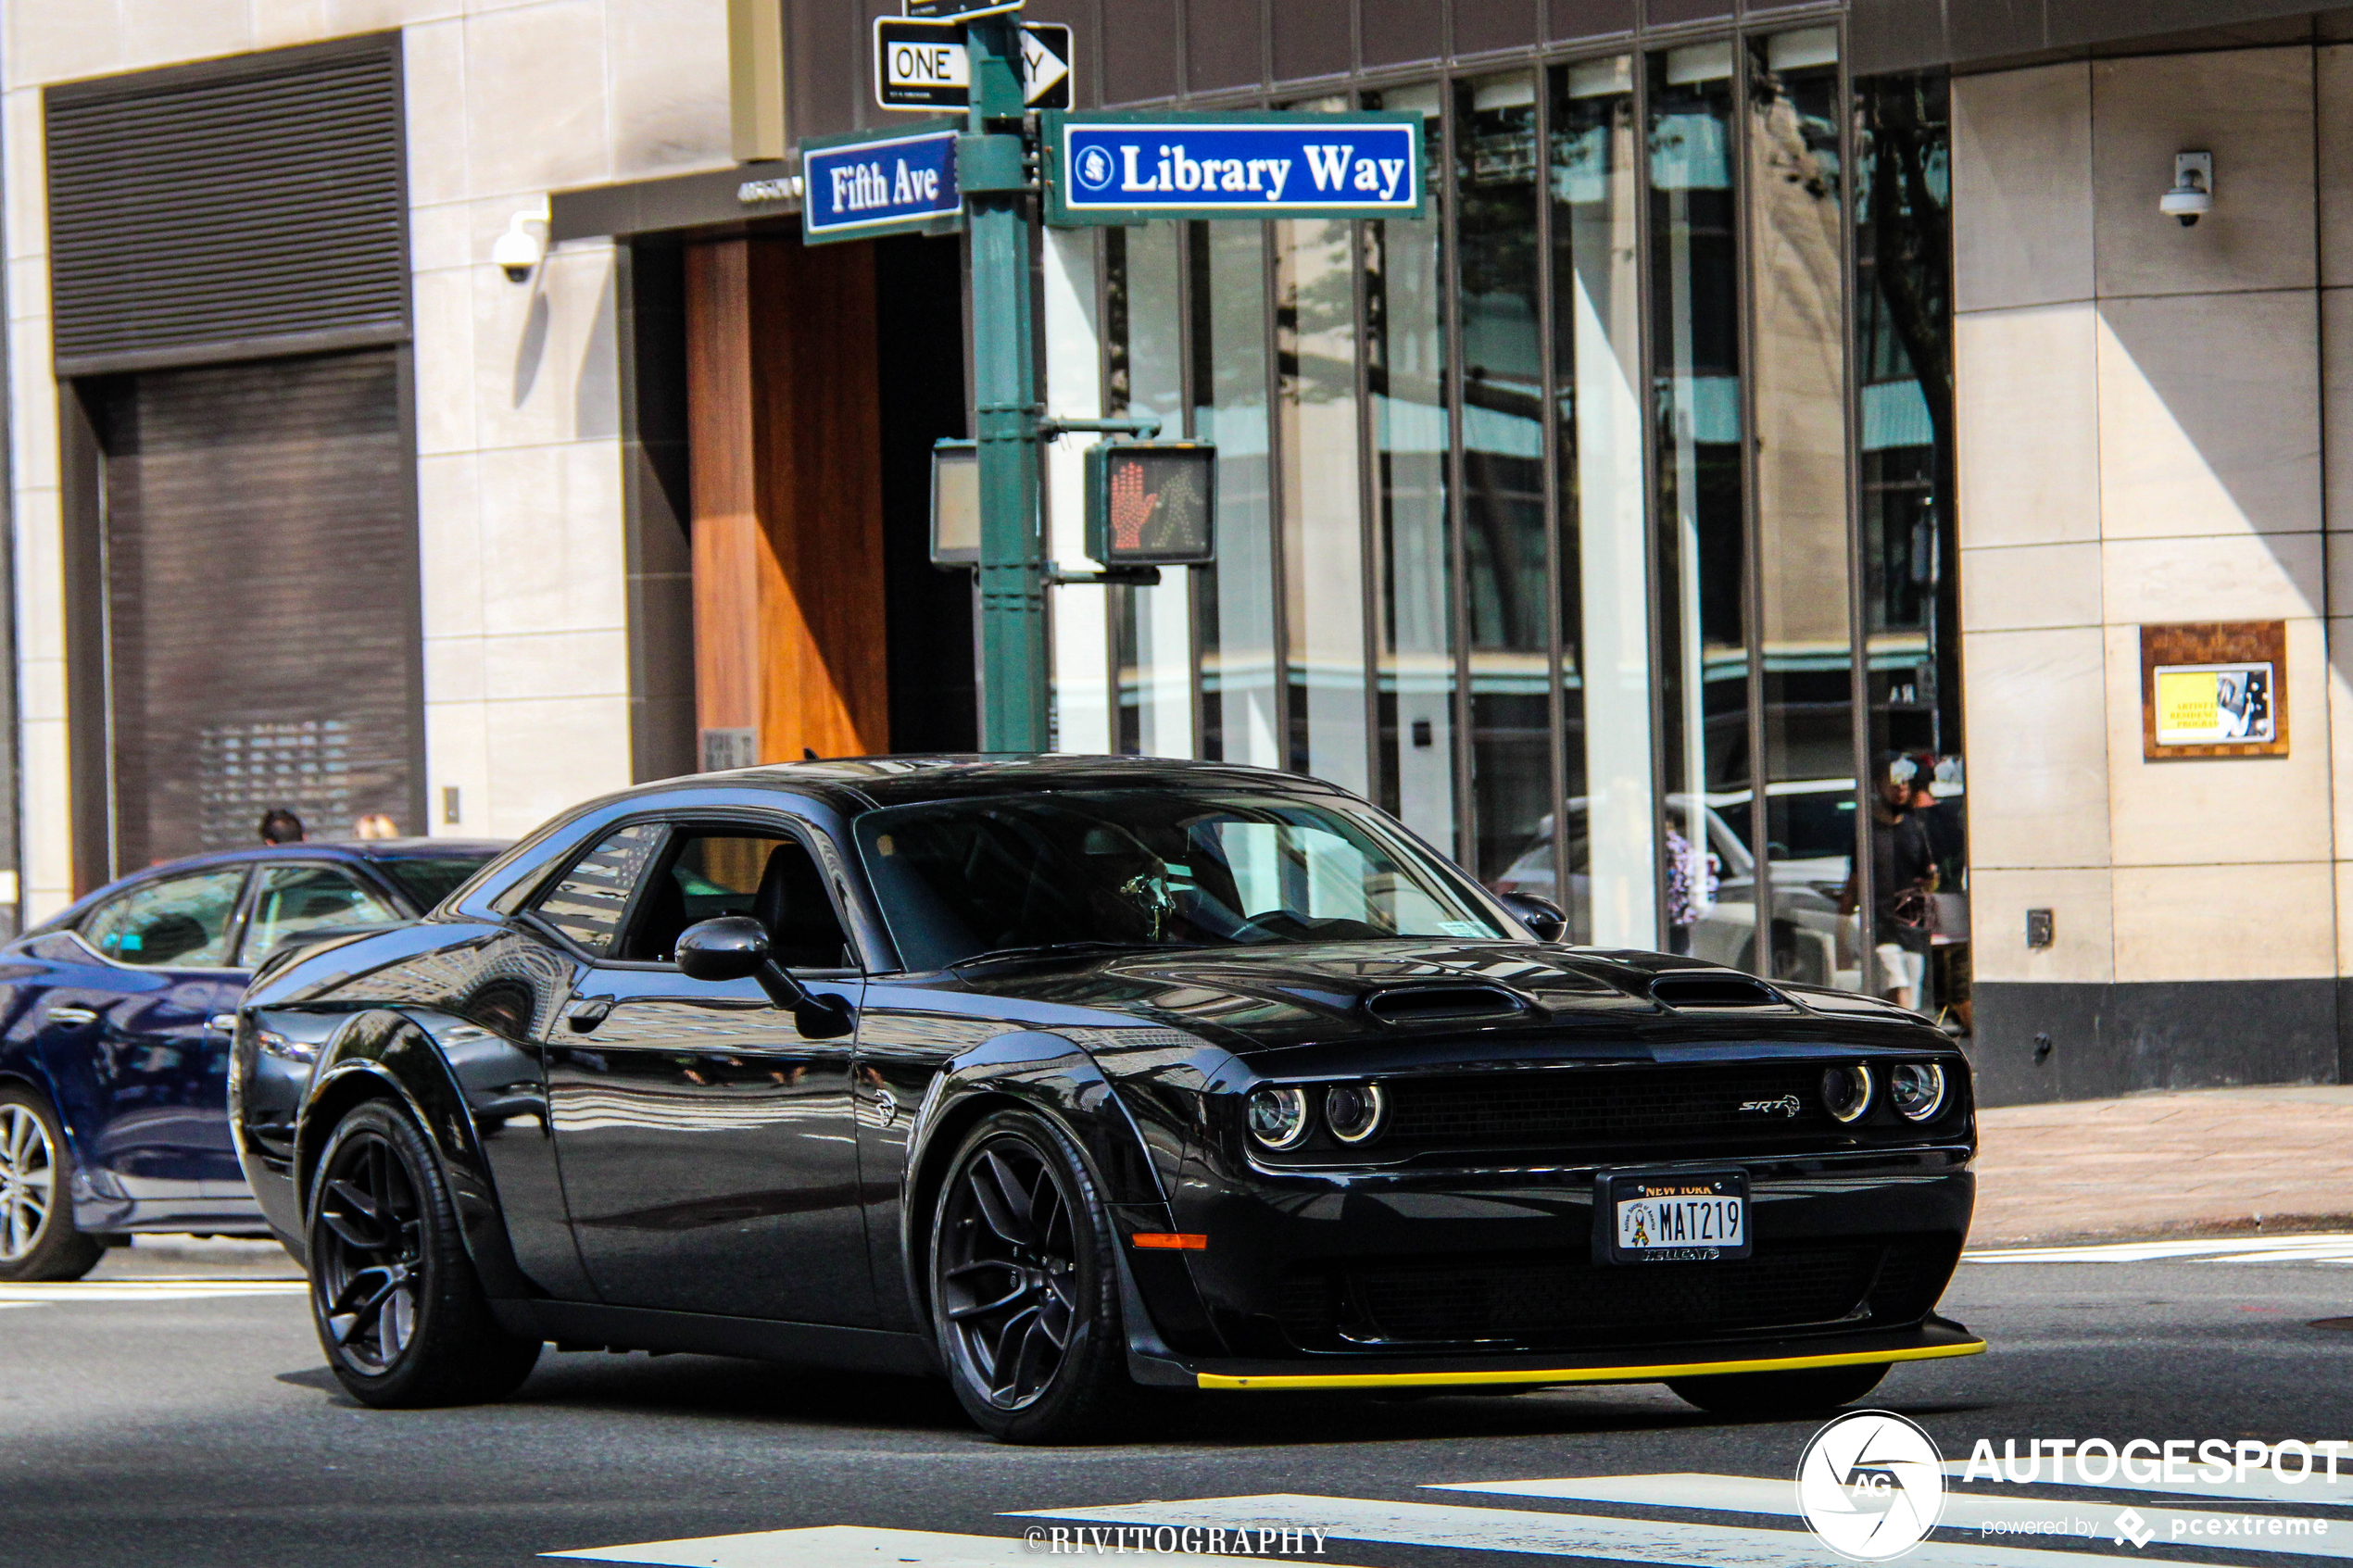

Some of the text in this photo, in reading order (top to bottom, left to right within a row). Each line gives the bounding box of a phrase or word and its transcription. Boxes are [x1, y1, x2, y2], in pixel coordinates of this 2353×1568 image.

[896, 46, 951, 80] ONE
[830, 161, 889, 213] Fifth
[893, 158, 939, 205] Ave
[1119, 144, 1404, 202] Library Way
[1739, 1100, 1787, 1112] SRT
[1645, 1186, 1713, 1197] NEW YORK
[1659, 1201, 1739, 1241] MAT219
[1642, 1248, 1710, 1261] HELLCAT
